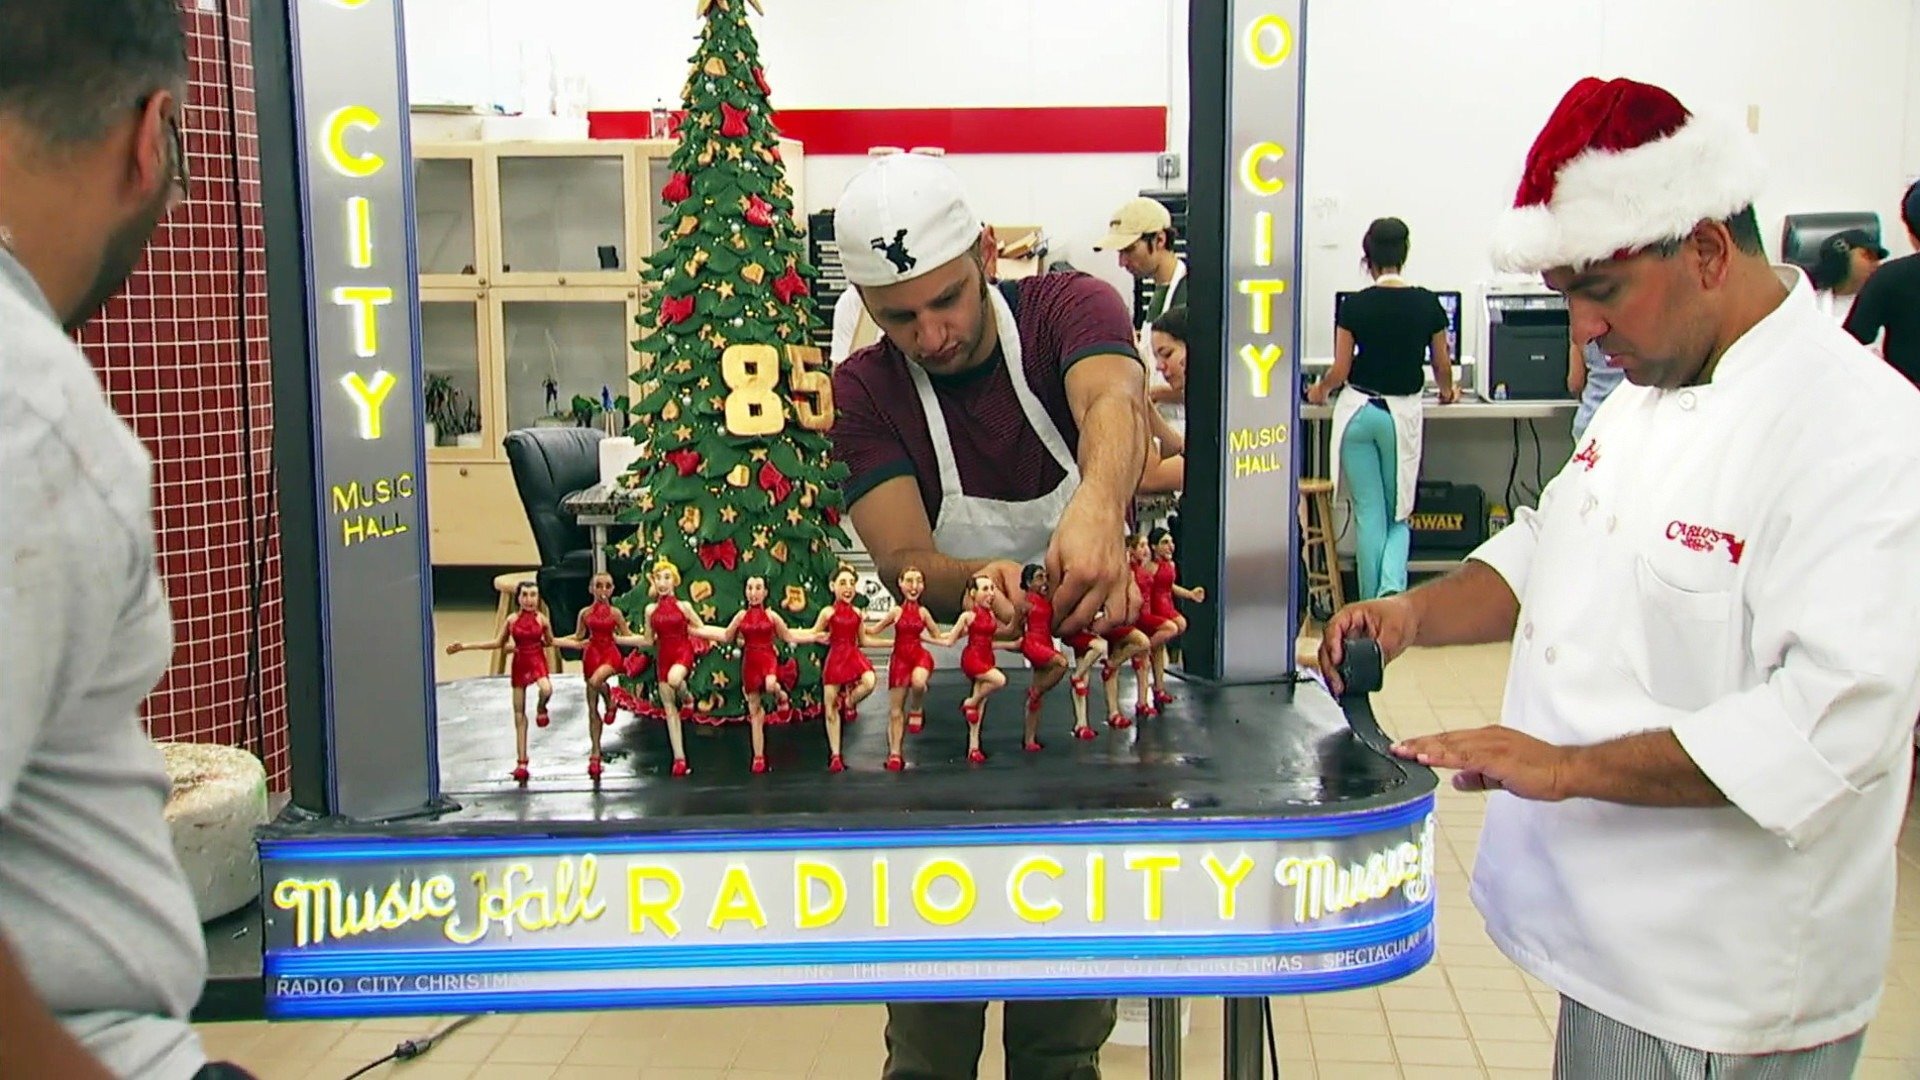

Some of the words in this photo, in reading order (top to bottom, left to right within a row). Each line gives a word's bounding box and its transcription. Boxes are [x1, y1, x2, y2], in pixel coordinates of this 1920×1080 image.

[320, 105, 396, 440] CITY
[1239, 141, 1286, 398] CITY
[722, 343, 835, 437] 85
[1229, 424, 1287, 455] MUSIC
[1235, 452, 1280, 479] HALL
[332, 473, 413, 515] MUSIC
[343, 513, 407, 547] HALL
[274, 873, 456, 947] Music
[445, 853, 606, 944] Hall
[627, 854, 977, 938] RADIO
[1006, 850, 1255, 925] CITY
[276, 976, 344, 996] RADIO
[357, 976, 405, 994] CITY
